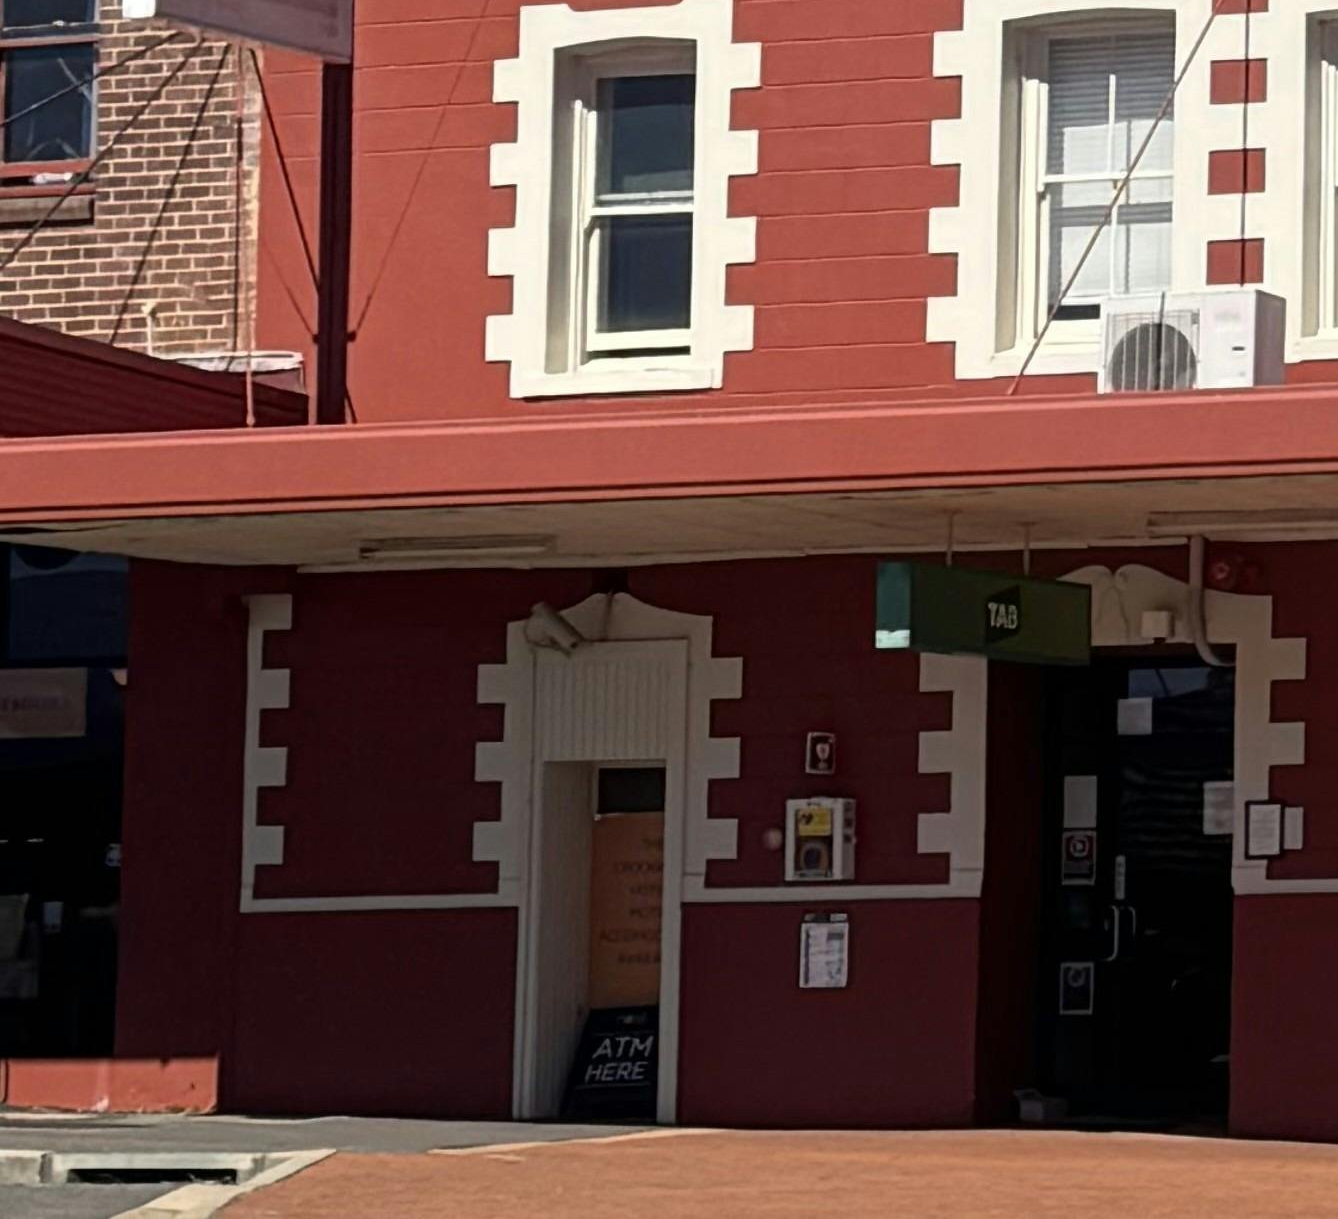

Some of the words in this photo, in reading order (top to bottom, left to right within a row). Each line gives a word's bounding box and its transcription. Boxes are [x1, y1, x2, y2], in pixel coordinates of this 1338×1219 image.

[988, 601, 1019, 629] TAB
[592, 1035, 653, 1058] ATM
[584, 1061, 648, 1083] HERE
